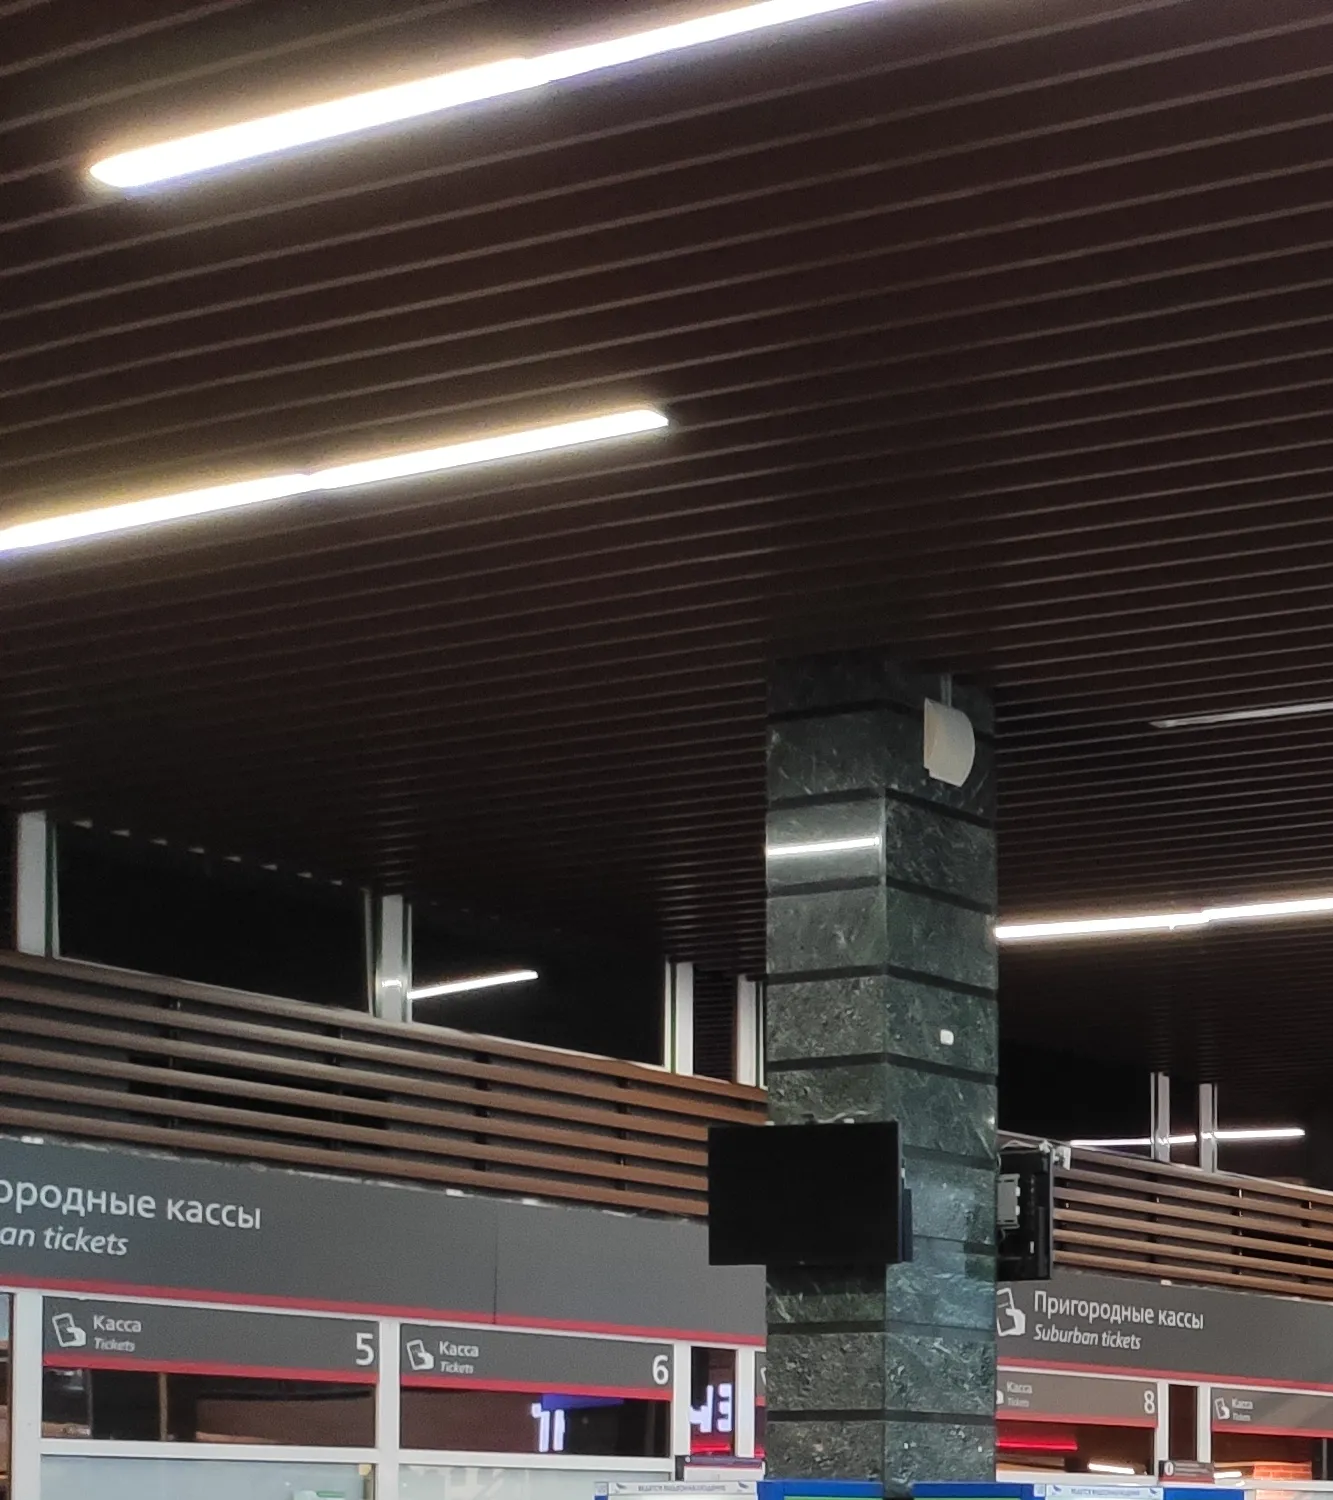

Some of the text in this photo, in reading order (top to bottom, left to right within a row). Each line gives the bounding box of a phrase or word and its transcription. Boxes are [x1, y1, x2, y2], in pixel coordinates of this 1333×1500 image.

[166, 1197, 262, 1230] кассы
[43, 1225, 130, 1256] tickets
[1033, 1290, 1204, 1330] Пригородные кассы
[93, 1314, 142, 1334] Касса
[1033, 1323, 1142, 1350] Suburban tickets
[93, 1336, 136, 1353] Tickets
[354, 1332, 375, 1366] 5
[439, 1340, 480, 1358] Касса
[439, 1360, 474, 1375] Tickets
[651, 1354, 670, 1386] 6
[1143, 1389, 1156, 1415] 8
